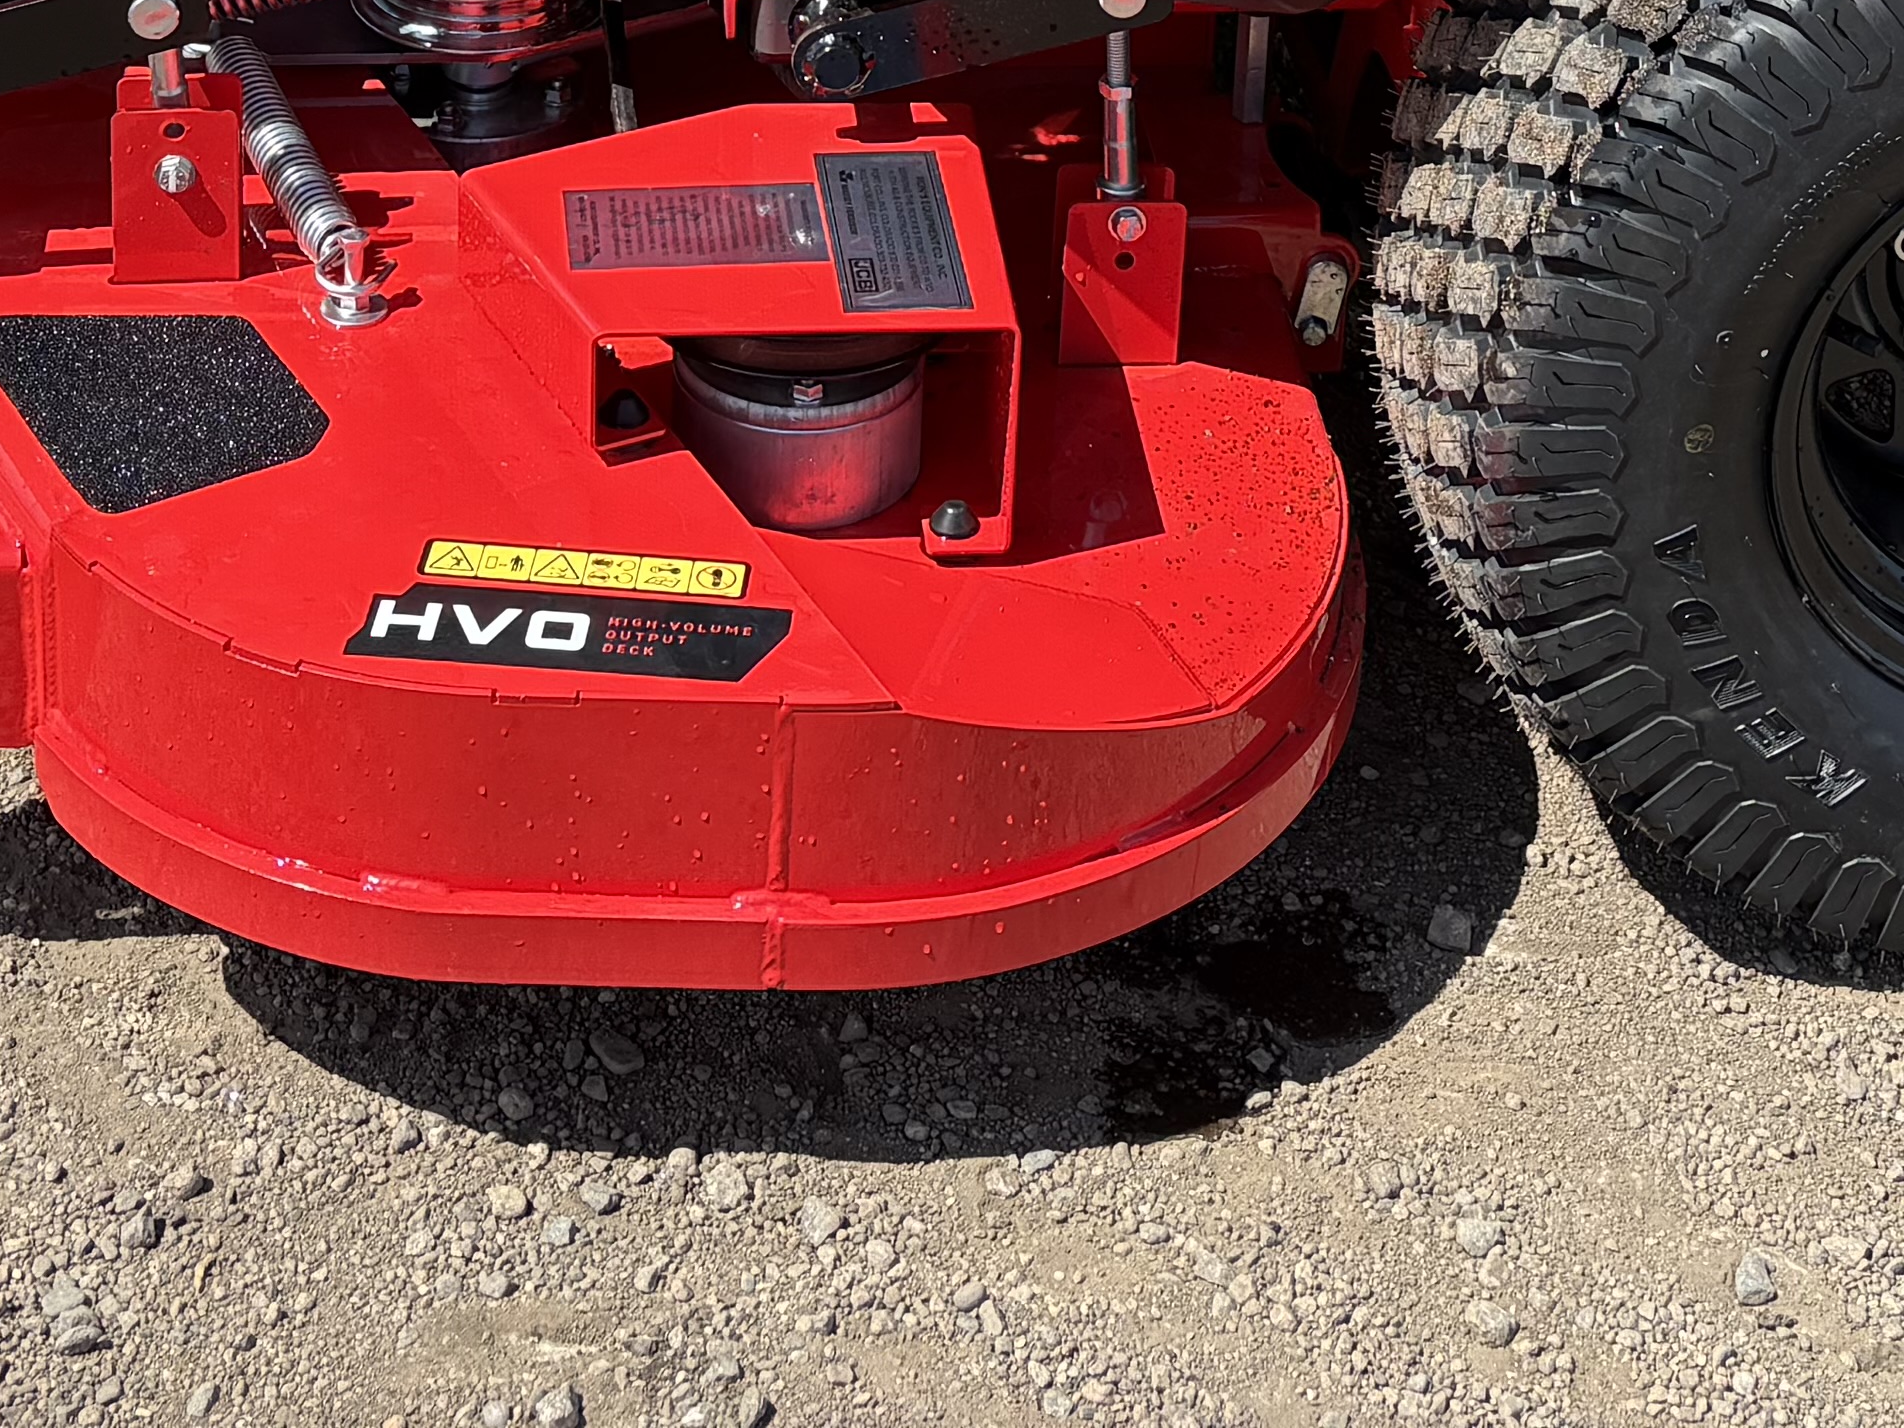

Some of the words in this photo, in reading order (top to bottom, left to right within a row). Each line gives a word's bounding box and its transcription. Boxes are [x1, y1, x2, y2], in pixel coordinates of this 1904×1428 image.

[854, 259, 874, 290] JCB
[369, 598, 591, 652] HVO
[605, 629, 688, 646] OUTPUT
[601, 642, 655, 657] DECK
[1654, 523, 1871, 806] KENDA
